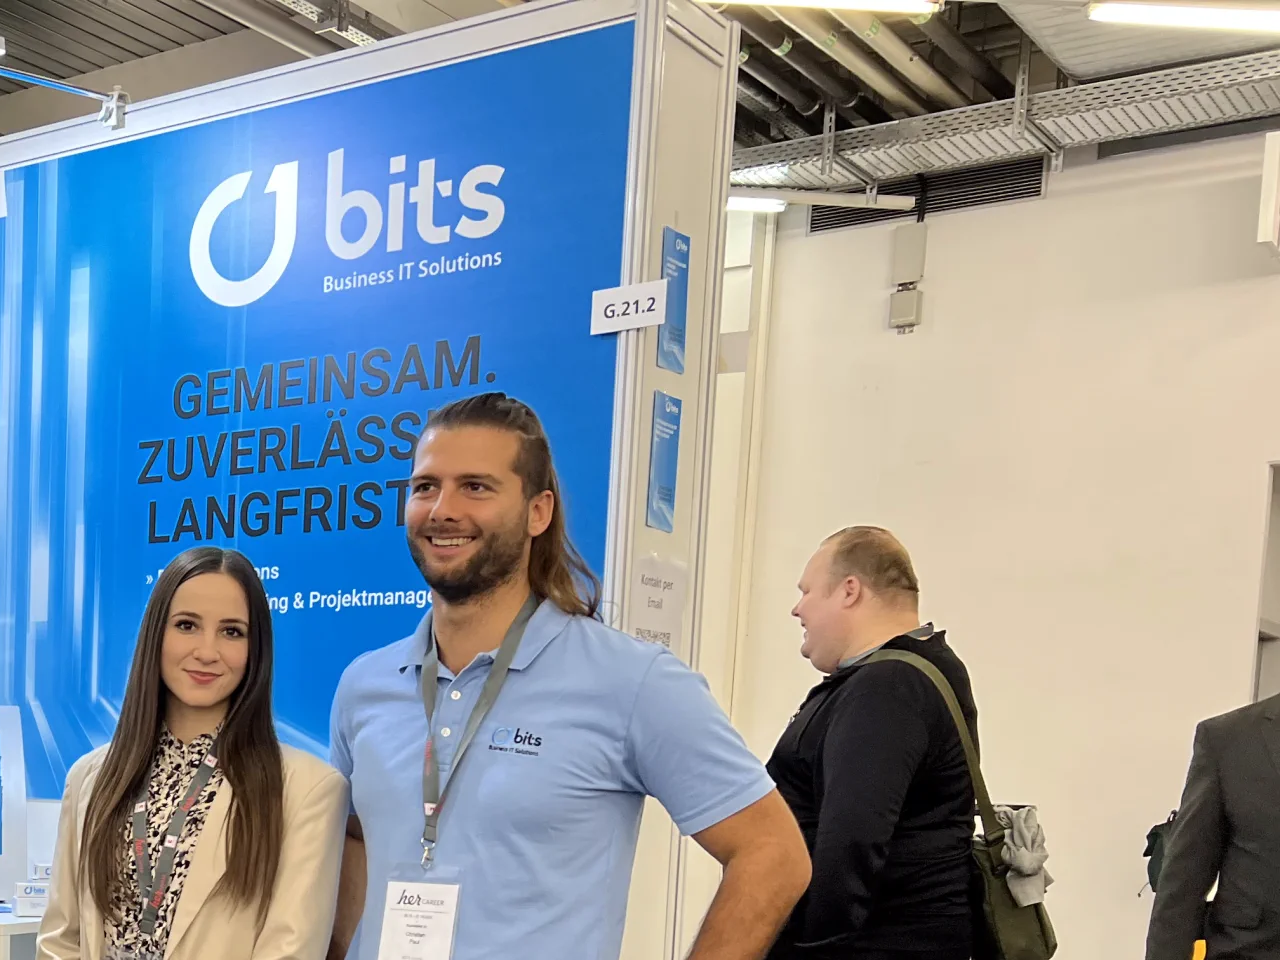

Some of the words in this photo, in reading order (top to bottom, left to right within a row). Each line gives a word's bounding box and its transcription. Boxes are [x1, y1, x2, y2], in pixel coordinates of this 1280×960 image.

[325, 147, 505, 260] bits
[323, 269, 394, 293] Business
[398, 262, 415, 281] IT
[418, 251, 502, 278] Solutions
[603, 297, 657, 320] G.21.2
[173, 335, 496, 420] GEMEINSAM.
[137, 410, 432, 484] ZUVERLÄSS
[148, 478, 410, 544] LANGFRIST
[293, 591, 304, 609] &
[663, 580, 674, 592] per
[513, 728, 542, 747] bits
